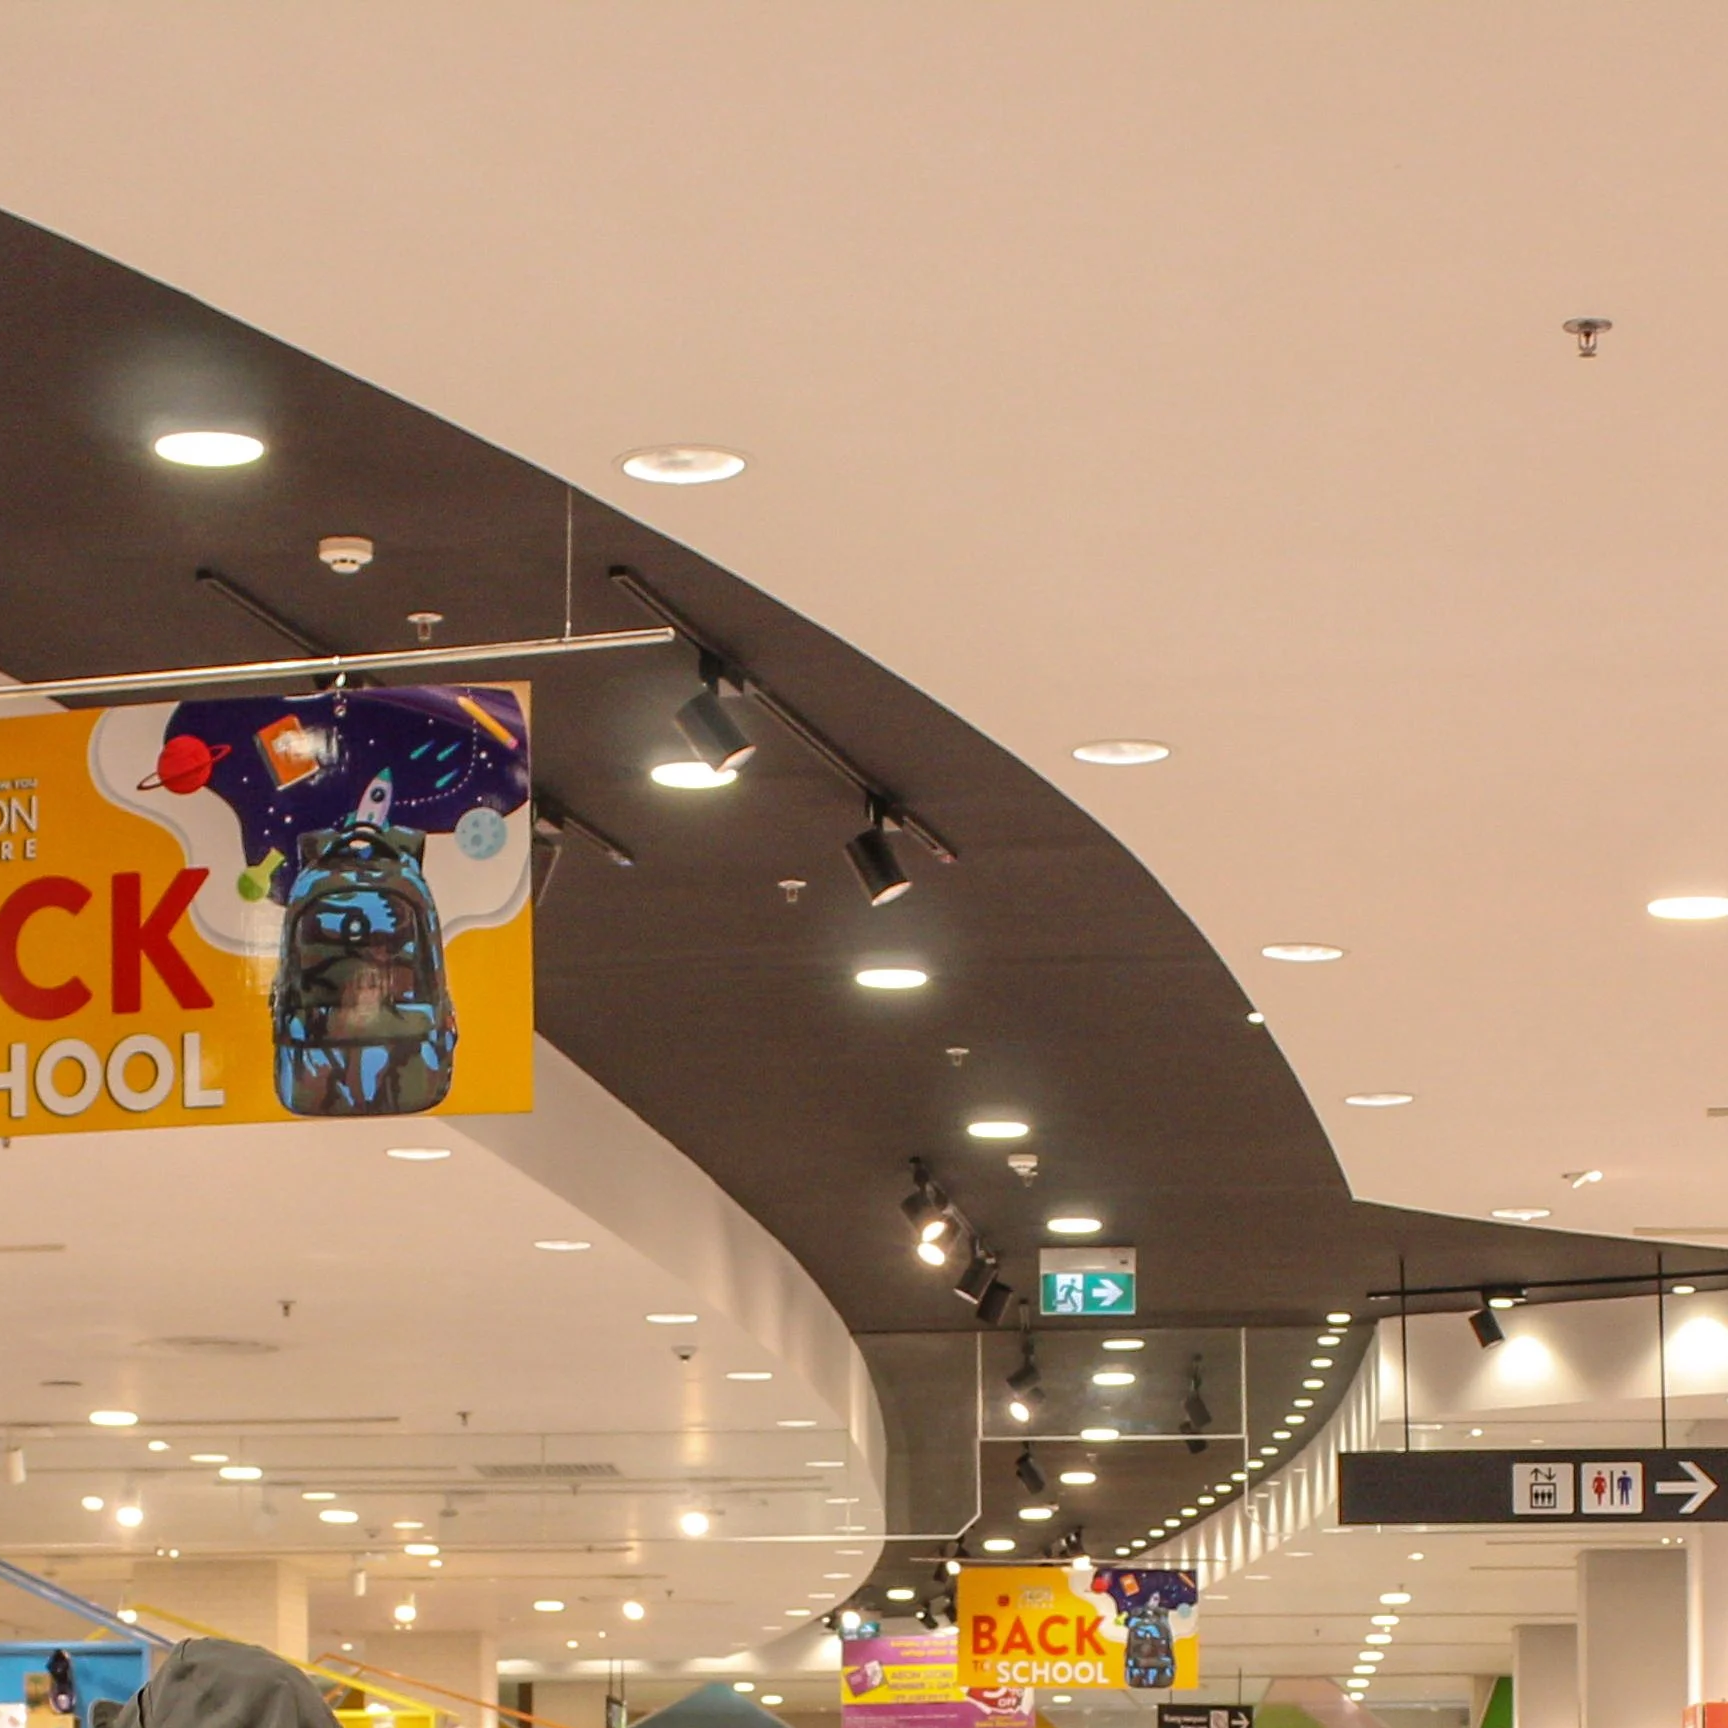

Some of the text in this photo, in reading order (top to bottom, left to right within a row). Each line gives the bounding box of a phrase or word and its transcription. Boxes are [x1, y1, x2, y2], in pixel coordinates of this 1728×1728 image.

[972, 1615, 1107, 1657] BACK
[973, 1660, 1110, 1685] TO SCHOOL
[998, 1698, 1017, 1708] OFF
